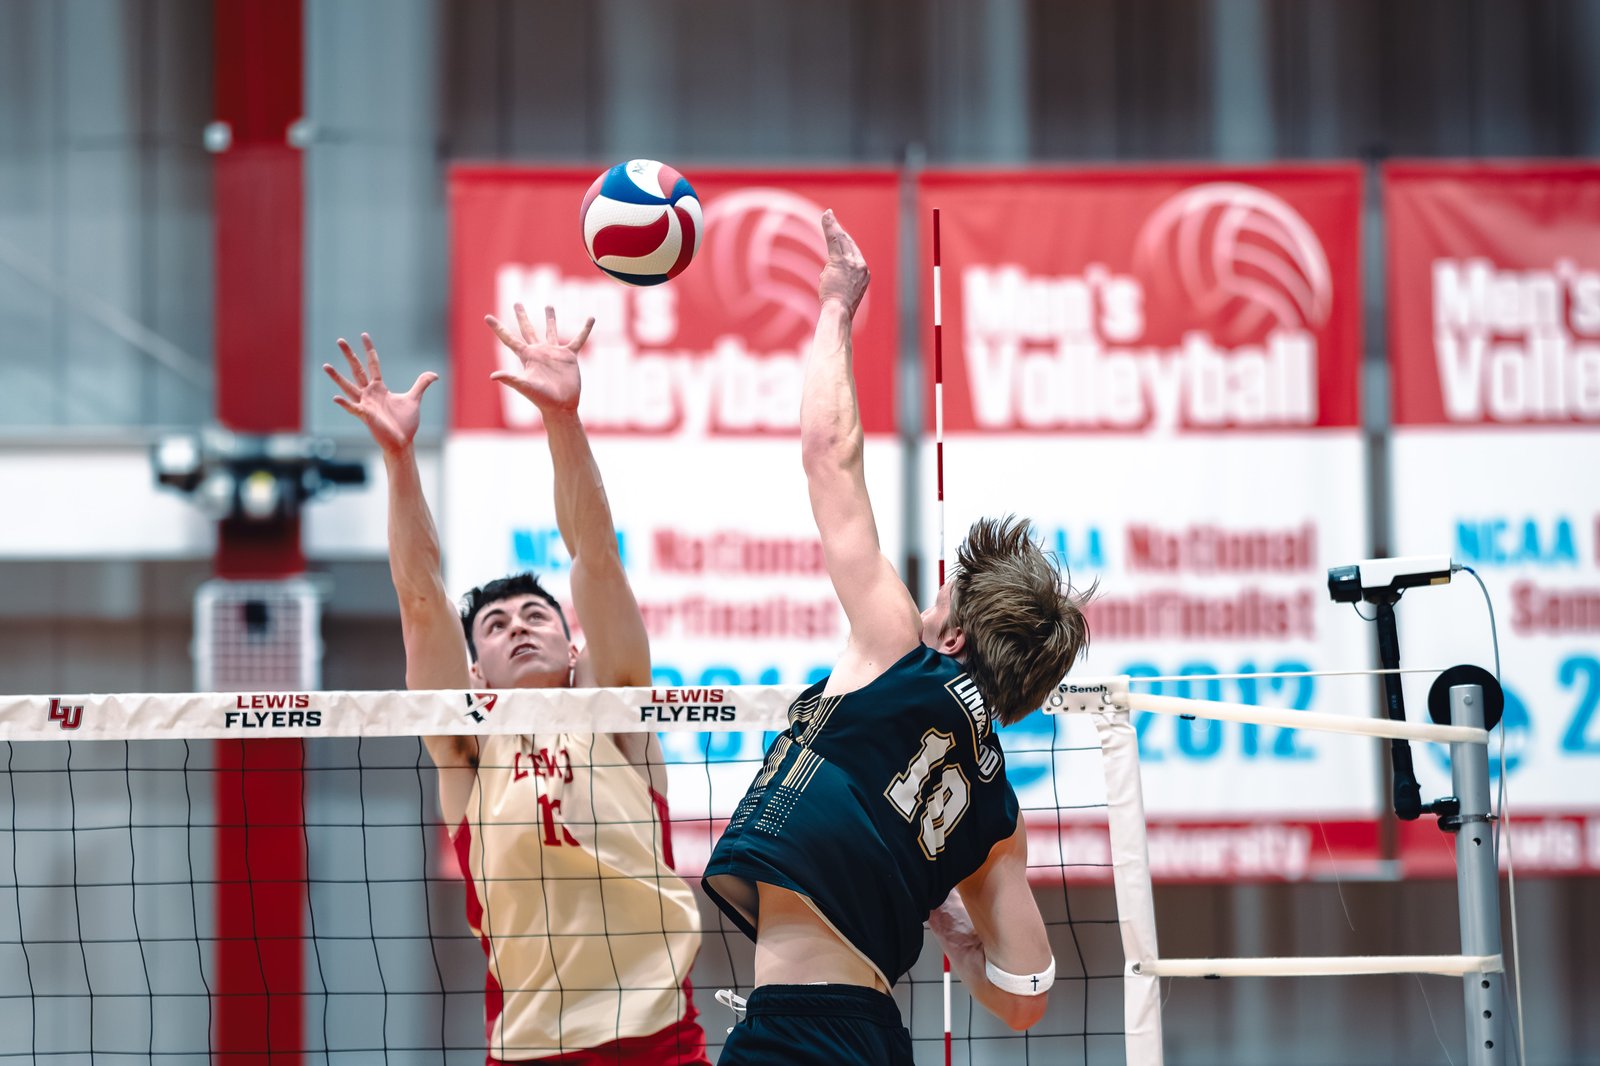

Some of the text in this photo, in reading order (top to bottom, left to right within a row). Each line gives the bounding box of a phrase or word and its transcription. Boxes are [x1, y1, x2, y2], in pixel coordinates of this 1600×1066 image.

[496, 263, 680, 345] Mens
[963, 262, 1145, 342] Men's
[965, 330, 1317, 436] Volleyball
[653, 528, 829, 574] Nationa
[1125, 522, 1318, 573] National
[1455, 517, 1577, 566] NCAA
[236, 695, 309, 709] LEWIS
[651, 689, 724, 703] LEWIS
[1070, 685, 1107, 693] Senoh
[1120, 657, 1316, 762] 2012
[48, 697, 84, 730] LU
[225, 711, 321, 728] FLYERS
[640, 706, 736, 722] FLYERS
